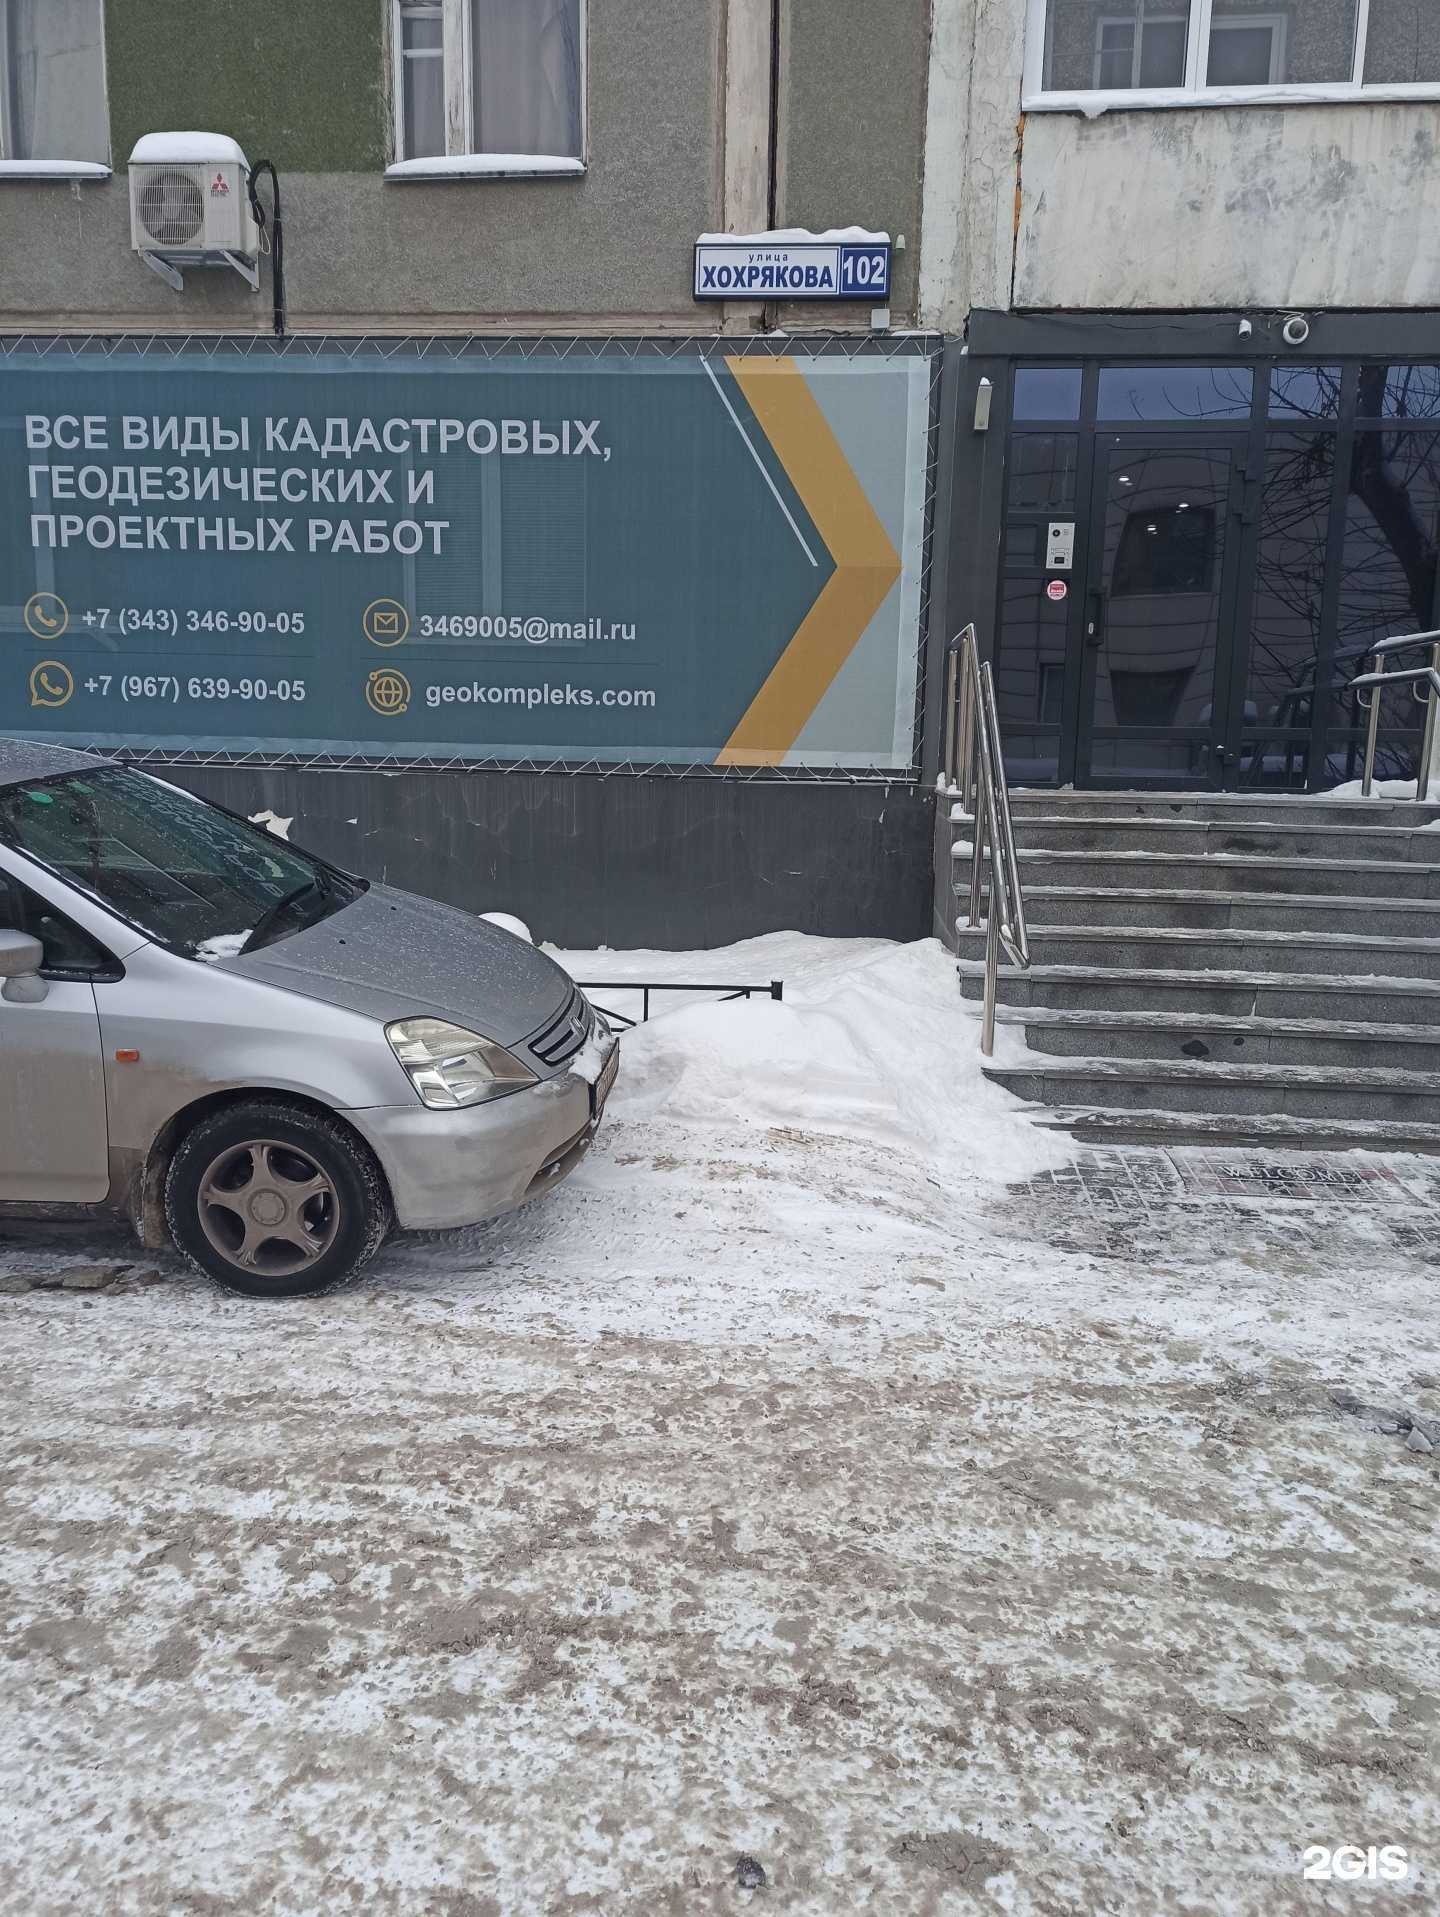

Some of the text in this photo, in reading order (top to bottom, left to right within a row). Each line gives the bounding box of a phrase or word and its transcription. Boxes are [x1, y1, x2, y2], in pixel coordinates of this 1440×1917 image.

[748, 252, 788, 264] улица
[843, 255, 886, 285] 102
[702, 265, 833, 289] ХОХРЯКОВА
[25, 415, 611, 462] ВСЕ ВИДЫ КАДАСТРОВЫХ,
[27, 465, 434, 506] ГЕОДЕЗИЧЕСКИХ И
[30, 514, 450, 555] ПРОЕКТНЫХ РАБОТ
[82, 608, 305, 636] +7 (343) 346-90-05
[420, 614, 636, 644] 3469005@mail.ru
[84, 675, 306, 703] +7 (967) 639-90-05
[426, 681, 656, 709] geokompleks.com
